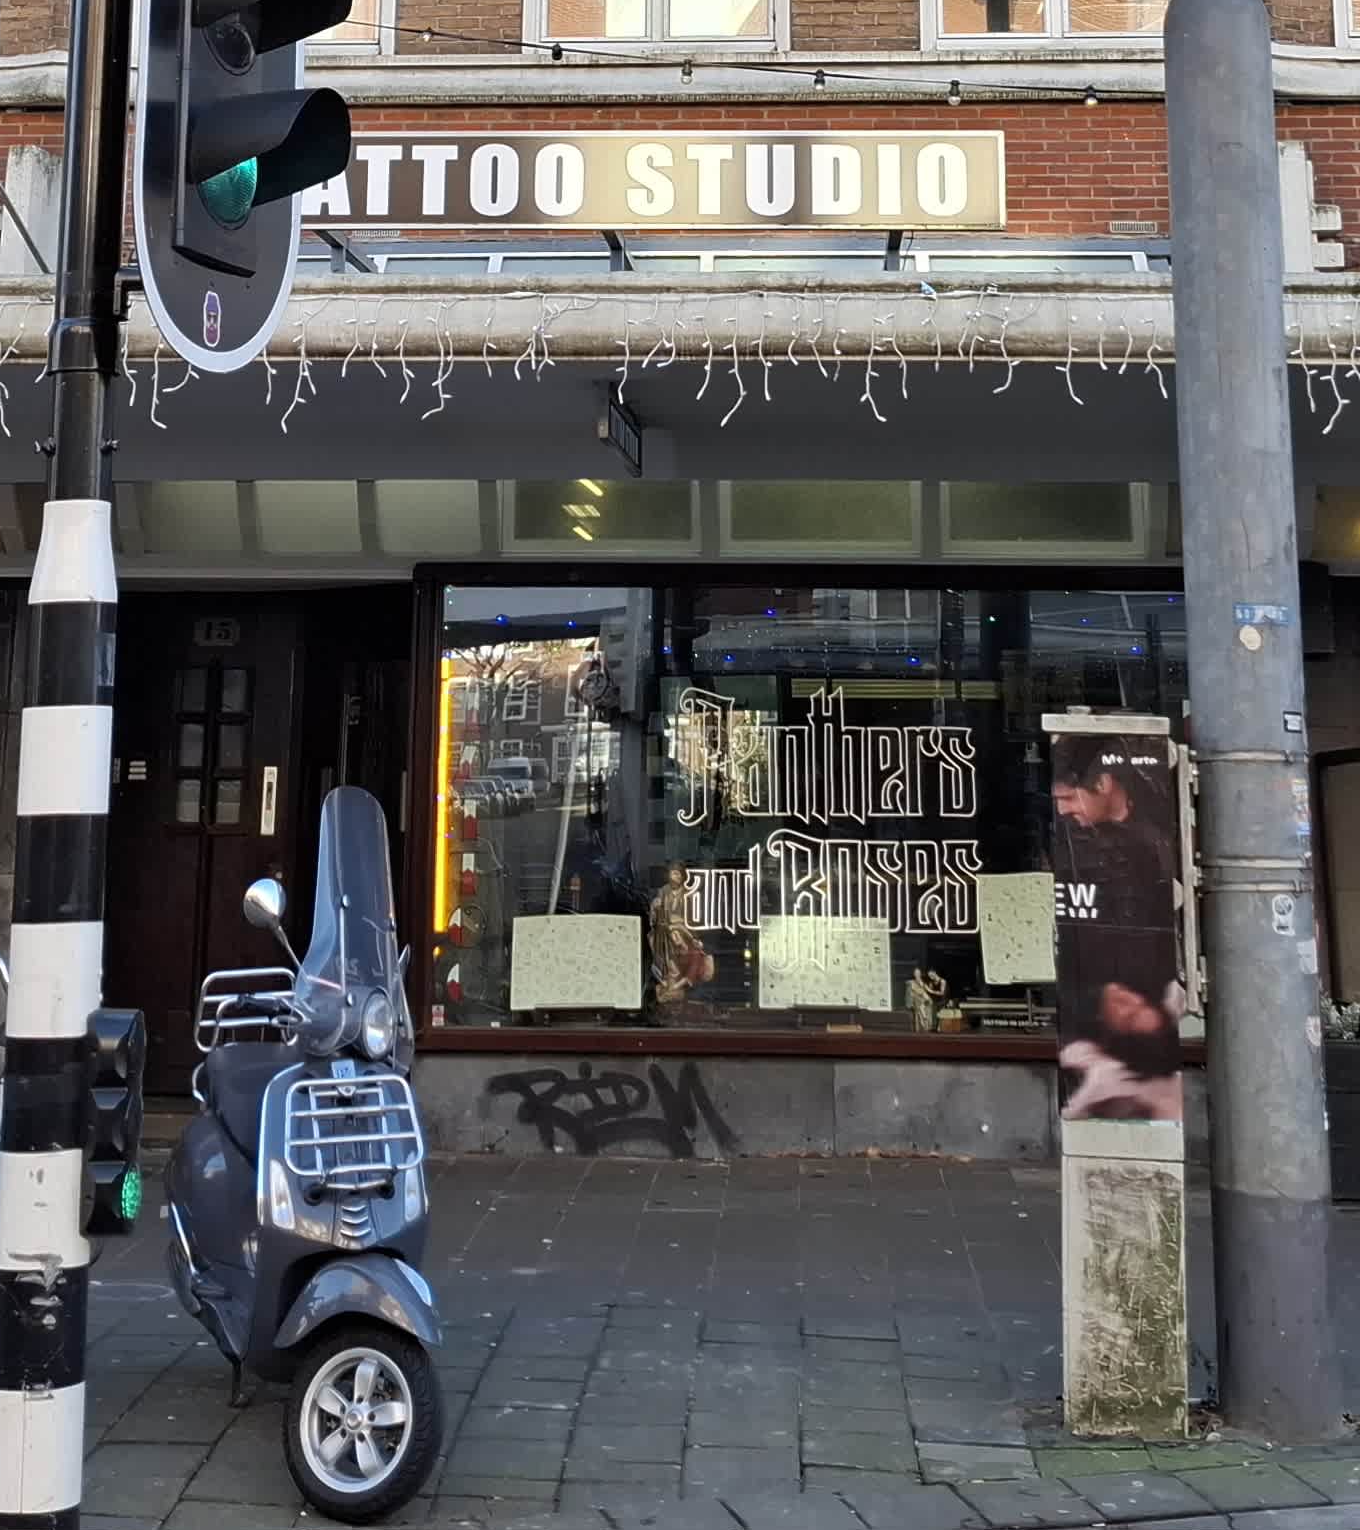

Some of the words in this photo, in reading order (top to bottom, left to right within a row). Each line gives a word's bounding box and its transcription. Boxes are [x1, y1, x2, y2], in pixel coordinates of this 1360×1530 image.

[302, 143, 585, 217] ATTOO
[625, 143, 969, 217] STUDIO
[684, 844, 761, 934] and
